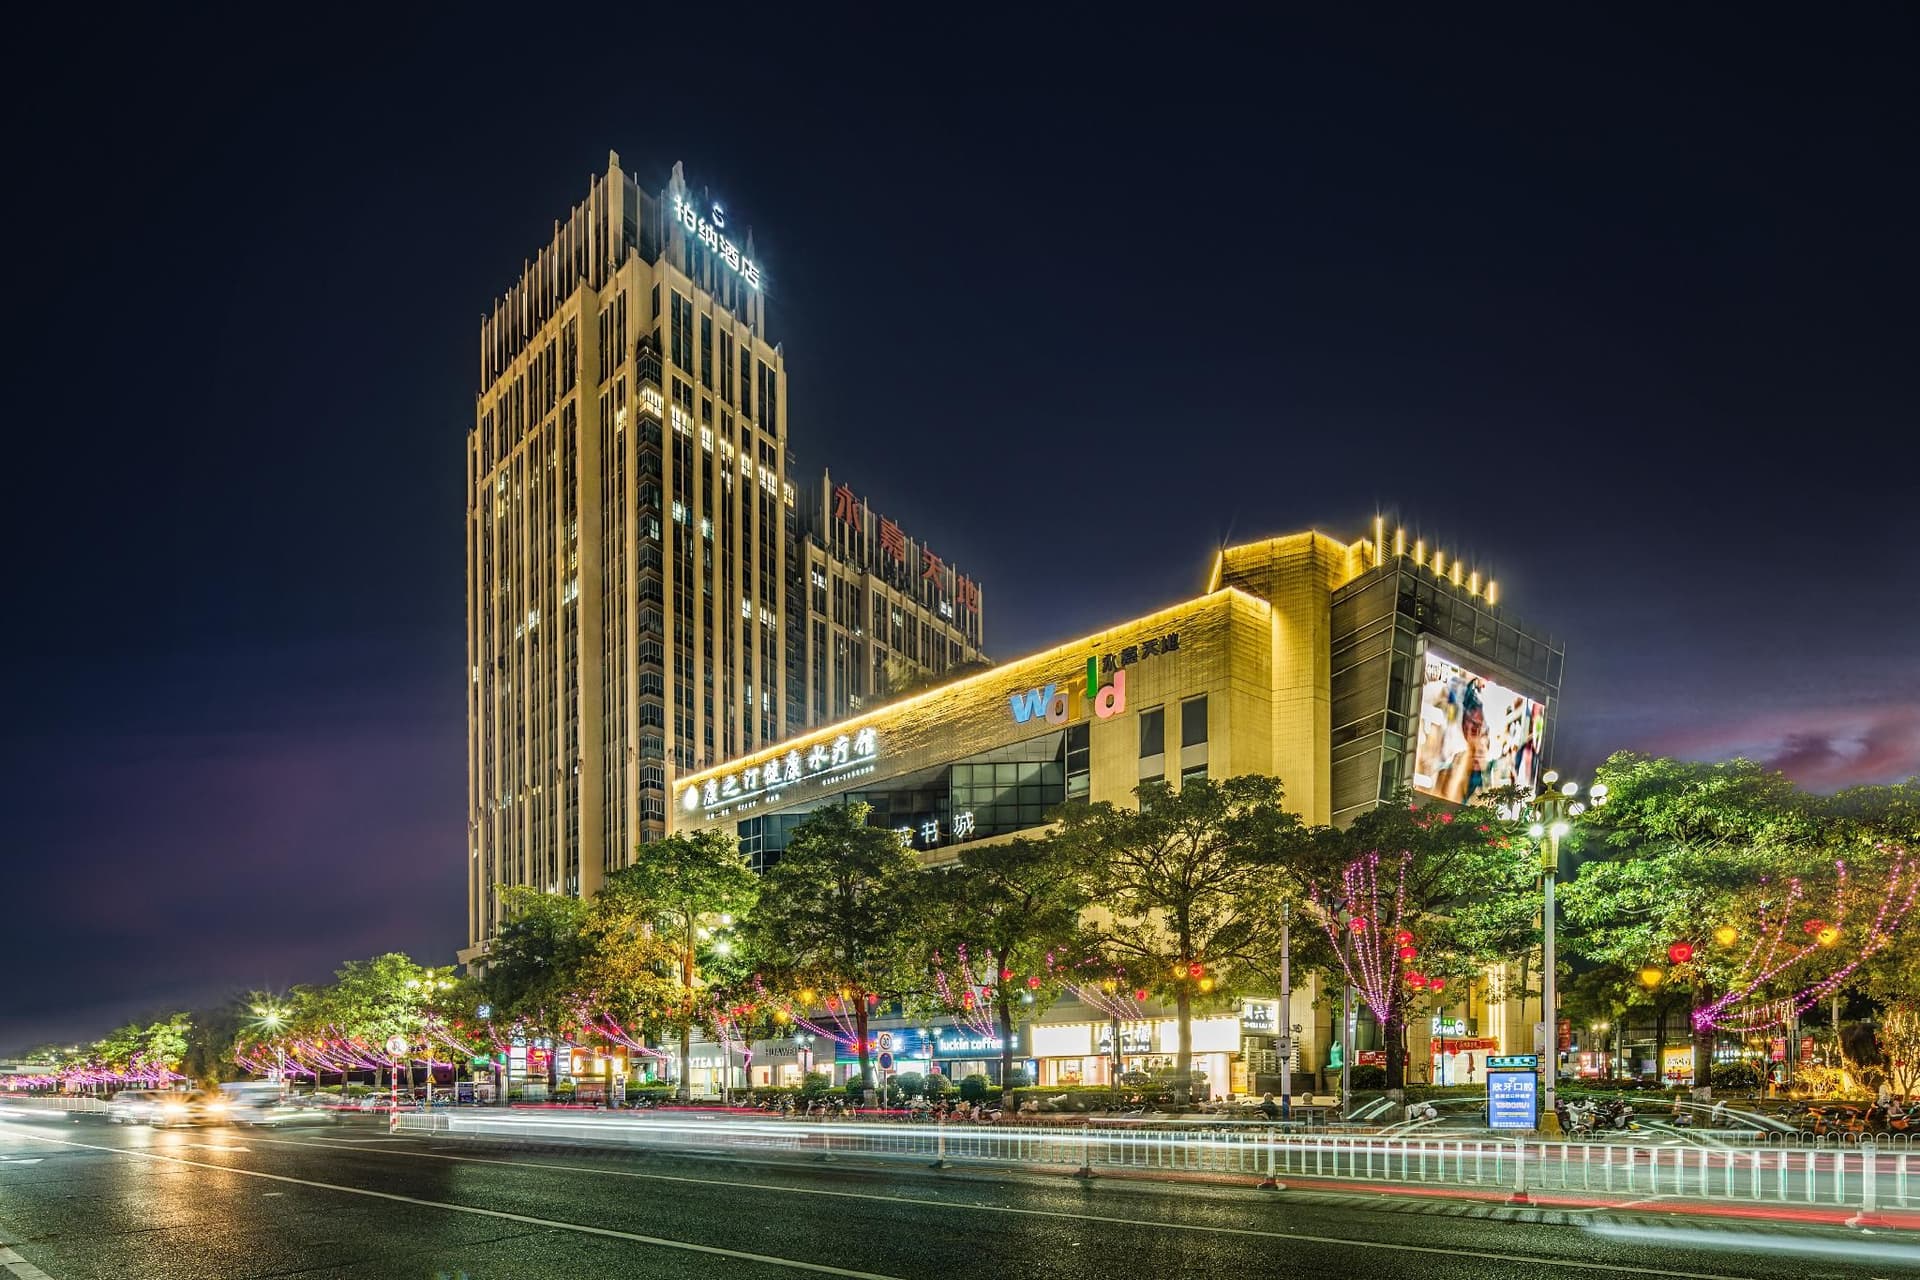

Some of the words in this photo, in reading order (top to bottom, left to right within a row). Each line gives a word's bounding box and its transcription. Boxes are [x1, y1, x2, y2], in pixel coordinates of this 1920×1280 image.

[1009, 655, 1126, 724] world
[940, 1037, 970, 1050] luckin
[765, 1047, 797, 1057] HUAWEI
